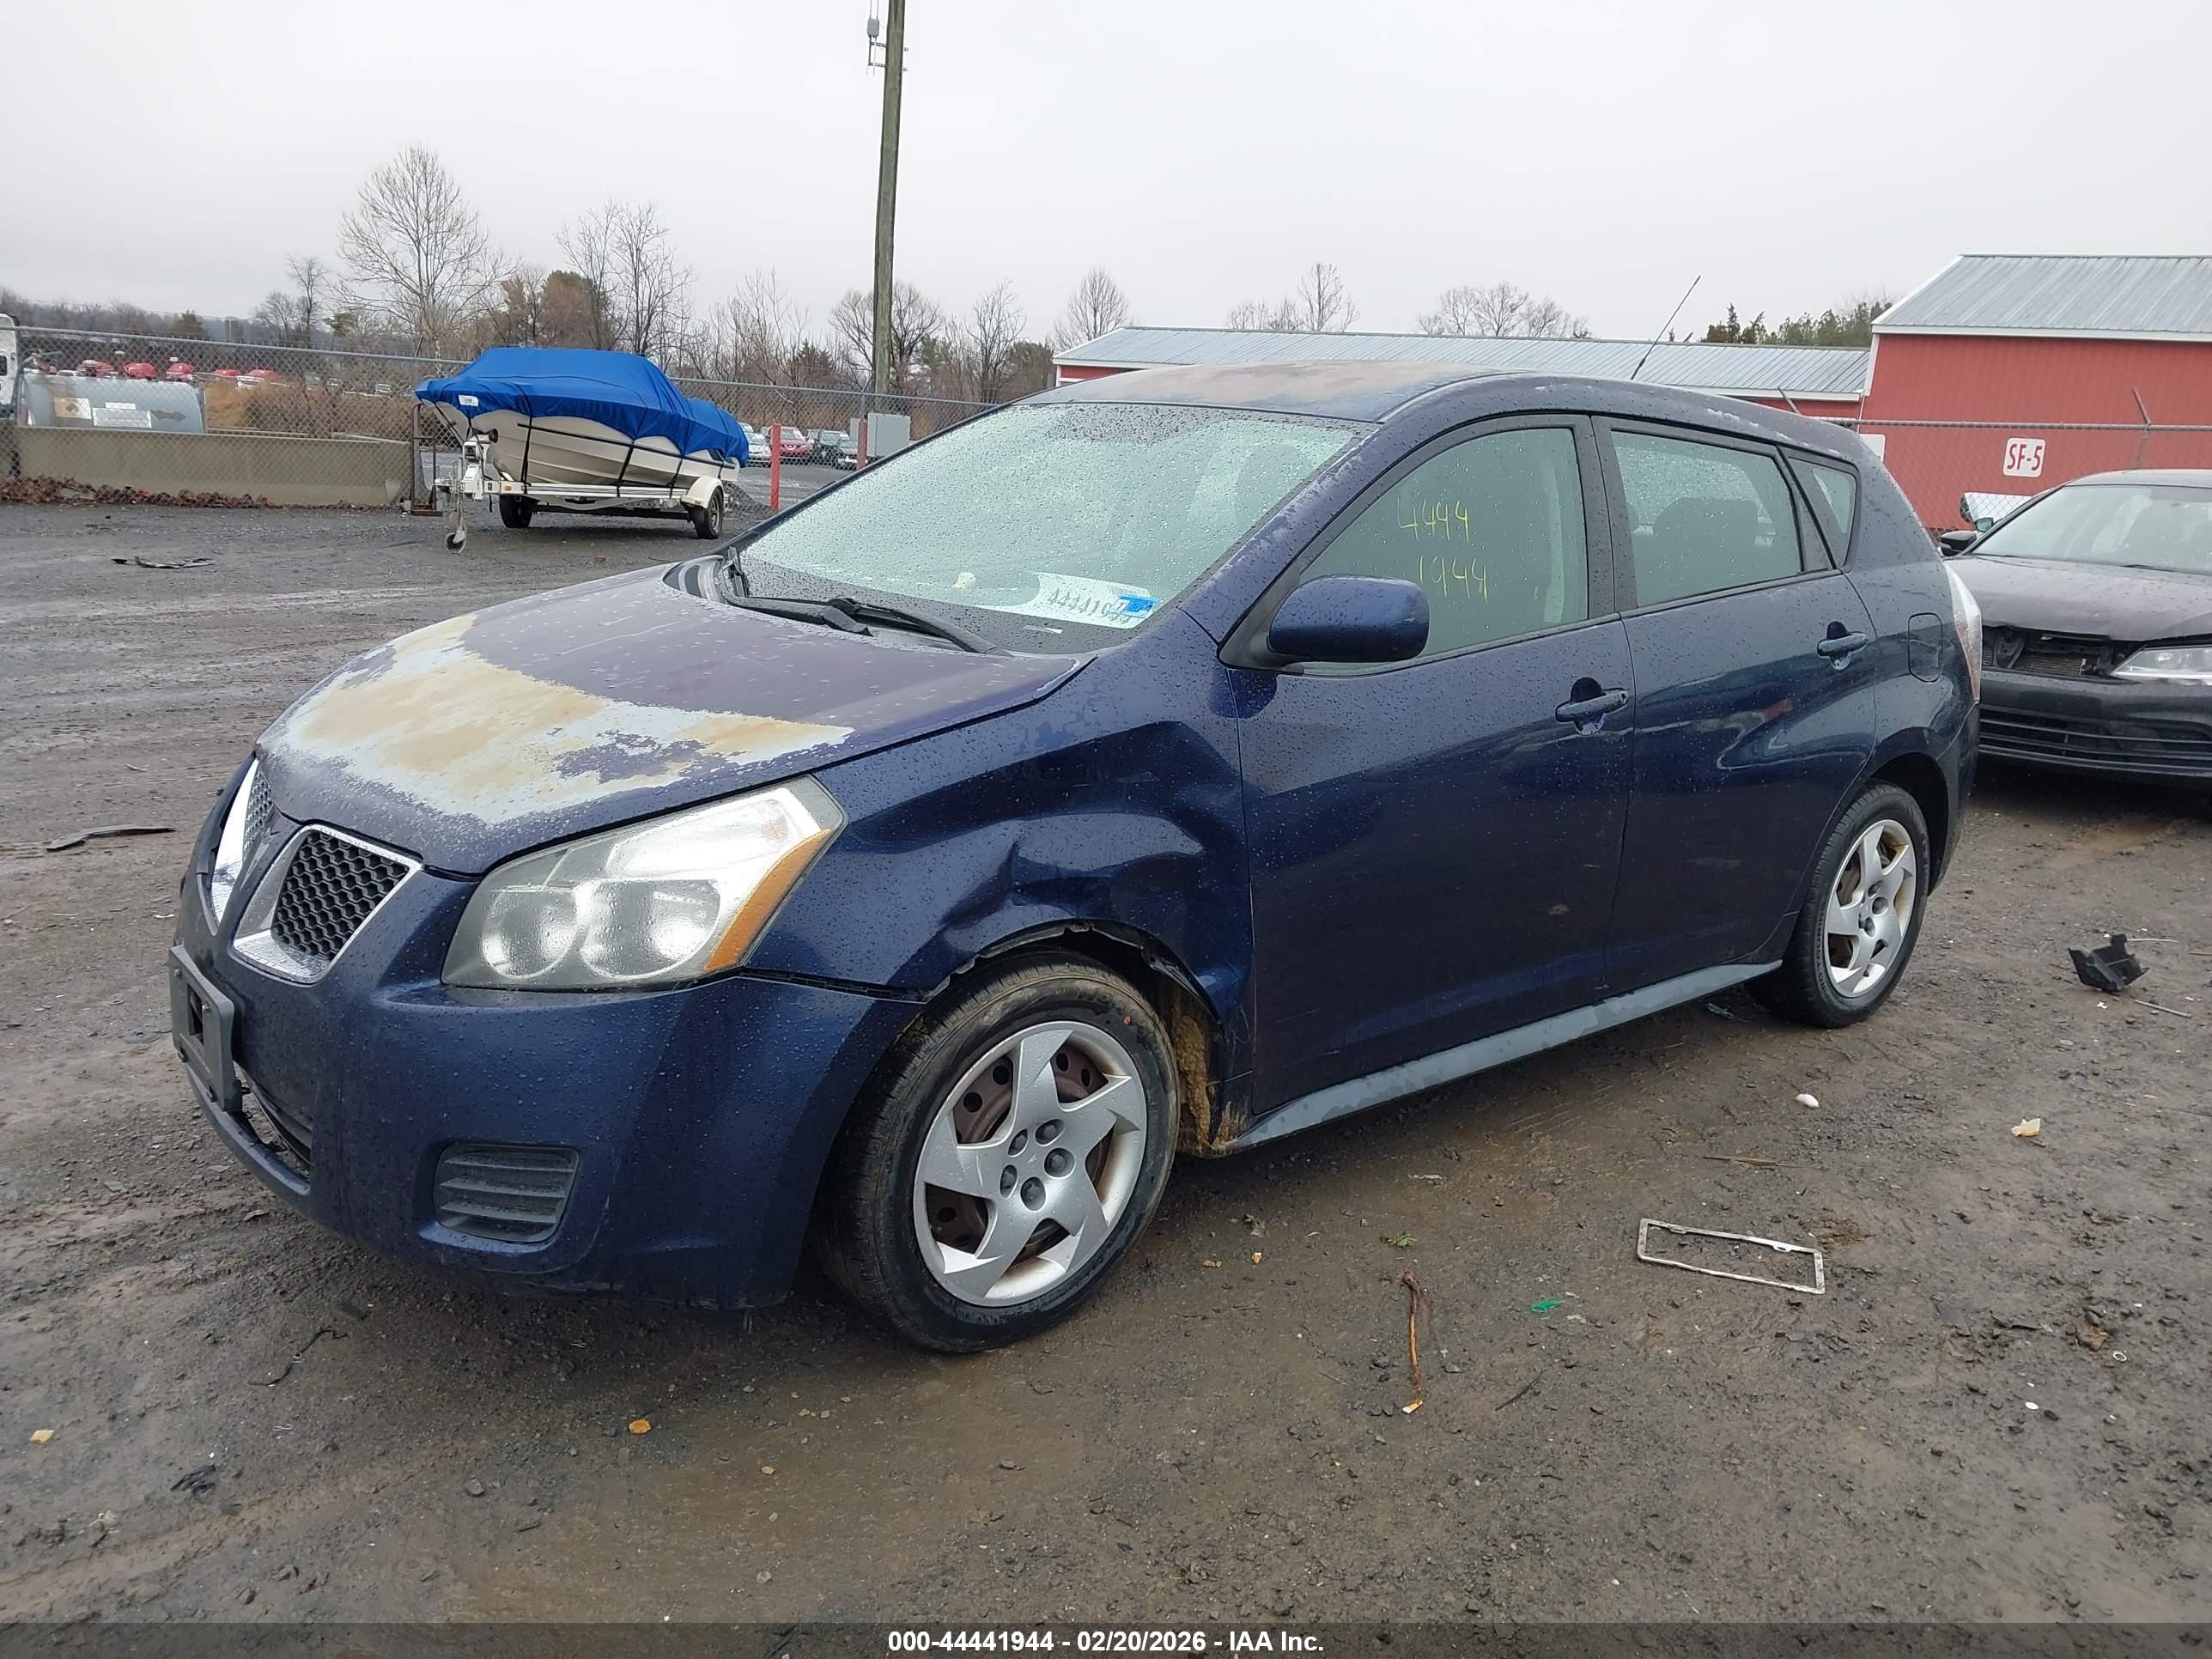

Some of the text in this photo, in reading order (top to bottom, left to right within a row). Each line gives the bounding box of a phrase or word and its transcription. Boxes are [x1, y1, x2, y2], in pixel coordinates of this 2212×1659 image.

[2007, 443, 2043, 471] SF-5
[1397, 496, 1469, 543] 4444
[1419, 556, 1487, 604] 1944
